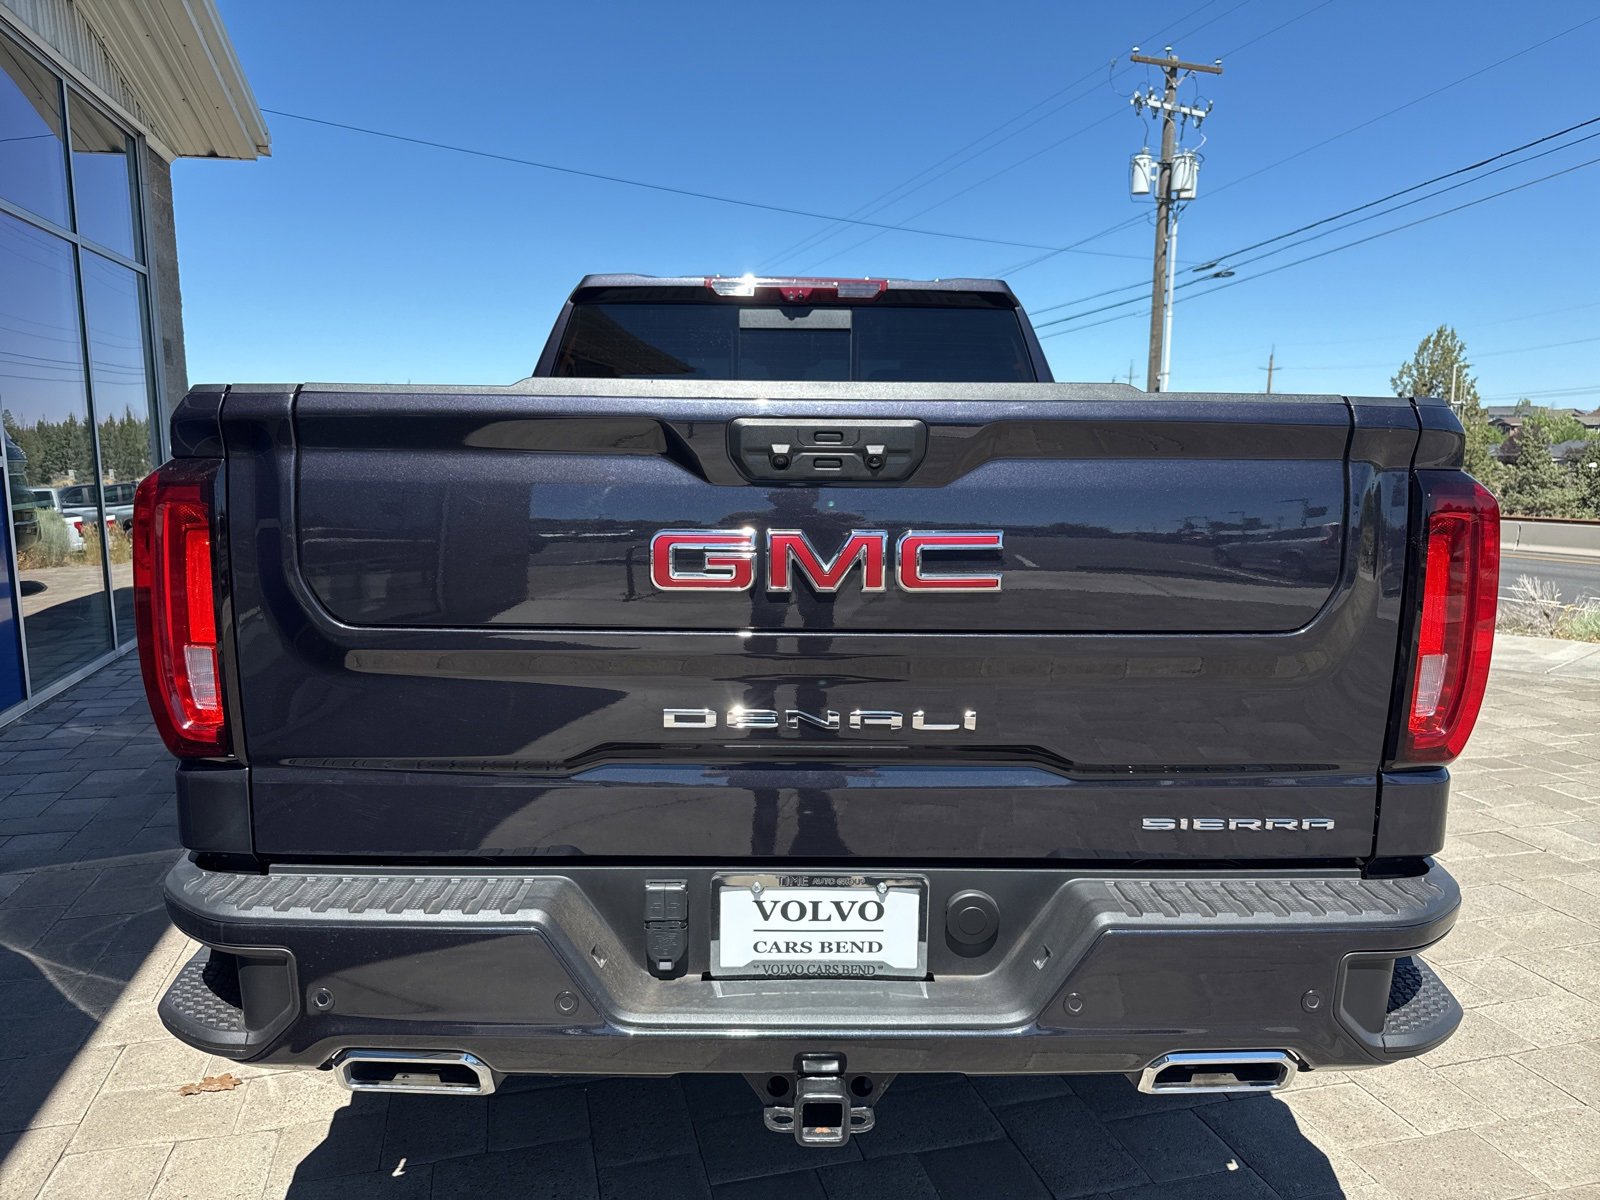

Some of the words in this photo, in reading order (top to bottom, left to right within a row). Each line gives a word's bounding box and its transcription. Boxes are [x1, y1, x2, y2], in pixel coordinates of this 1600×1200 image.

[650, 528, 1004, 593] GMC
[663, 708, 977, 730] DENALI
[1142, 818, 1335, 831] SIERRA
[752, 900, 885, 922] VOLVO
[752, 940, 813, 954] CARS
[818, 940, 883, 954] BEND
[762, 964, 804, 976] VOLVO
[807, 964, 839, 976] CARS
[842, 965, 876, 976] BEND
